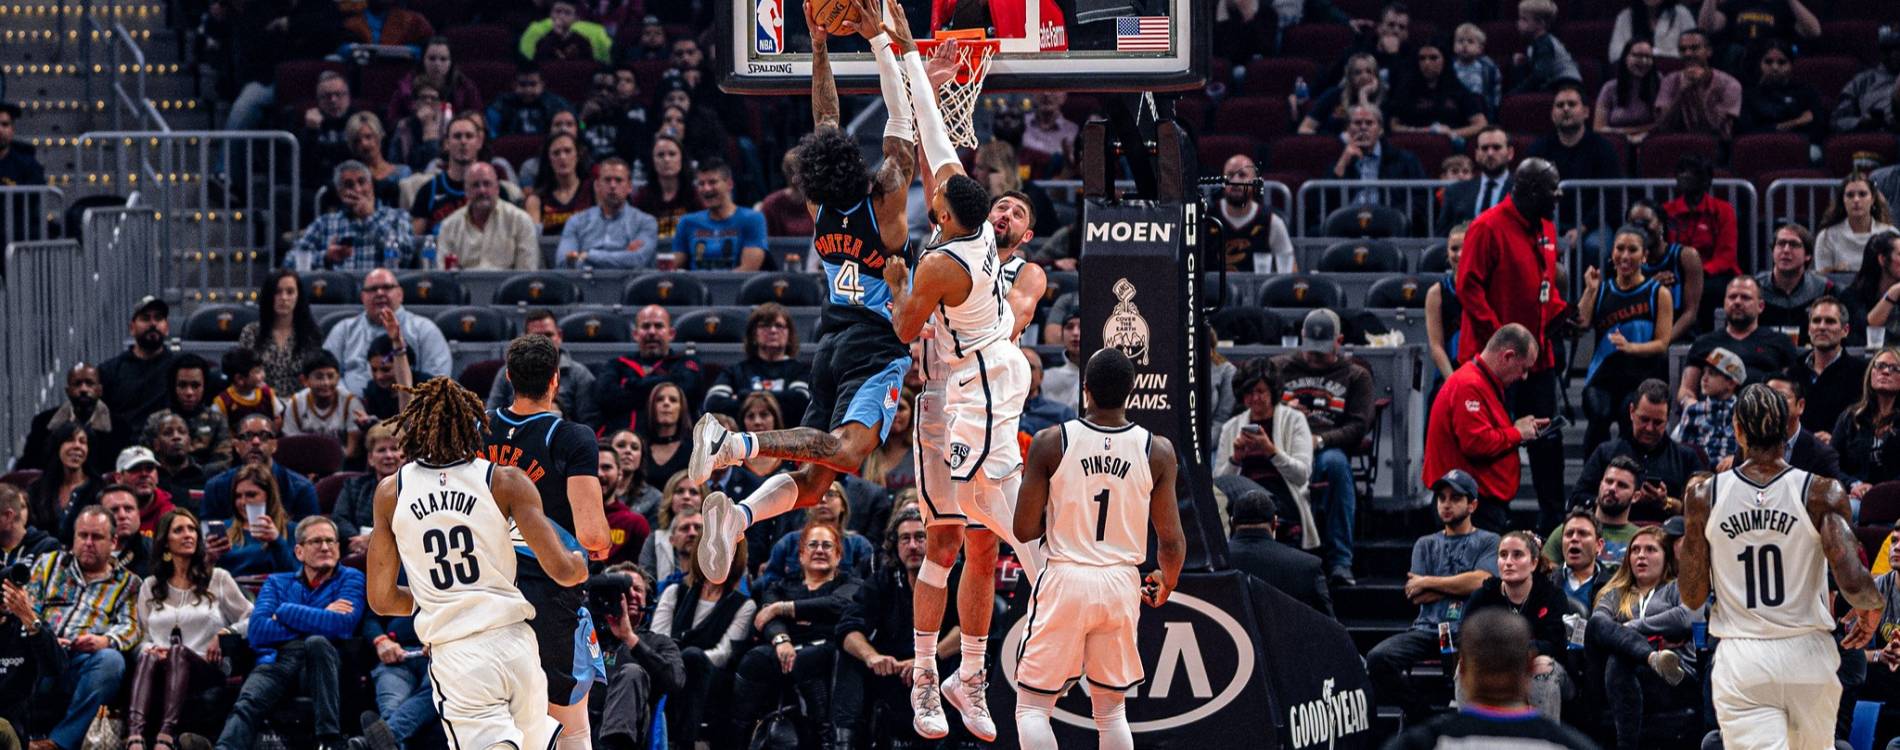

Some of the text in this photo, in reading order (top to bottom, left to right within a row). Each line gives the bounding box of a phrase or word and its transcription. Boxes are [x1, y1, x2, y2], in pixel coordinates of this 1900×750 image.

[760, 40, 773, 50] NBA
[748, 64, 792, 73] SPALDING
[815, 234, 863, 258] PORTER
[1086, 222, 1171, 242] MOEN
[834, 260, 864, 305] 4
[1187, 252, 1201, 464] Cleveland Clinic
[951, 445, 968, 457] ETS
[1080, 455, 1131, 479] PINSON
[410, 491, 477, 520] CLAXTON
[1093, 489, 1110, 541] 1
[1720, 509, 1798, 539] SHUMPERT
[423, 525, 480, 590] 33
[1737, 544, 1785, 609] 10
[1290, 688, 1369, 749] GOODYEAR
